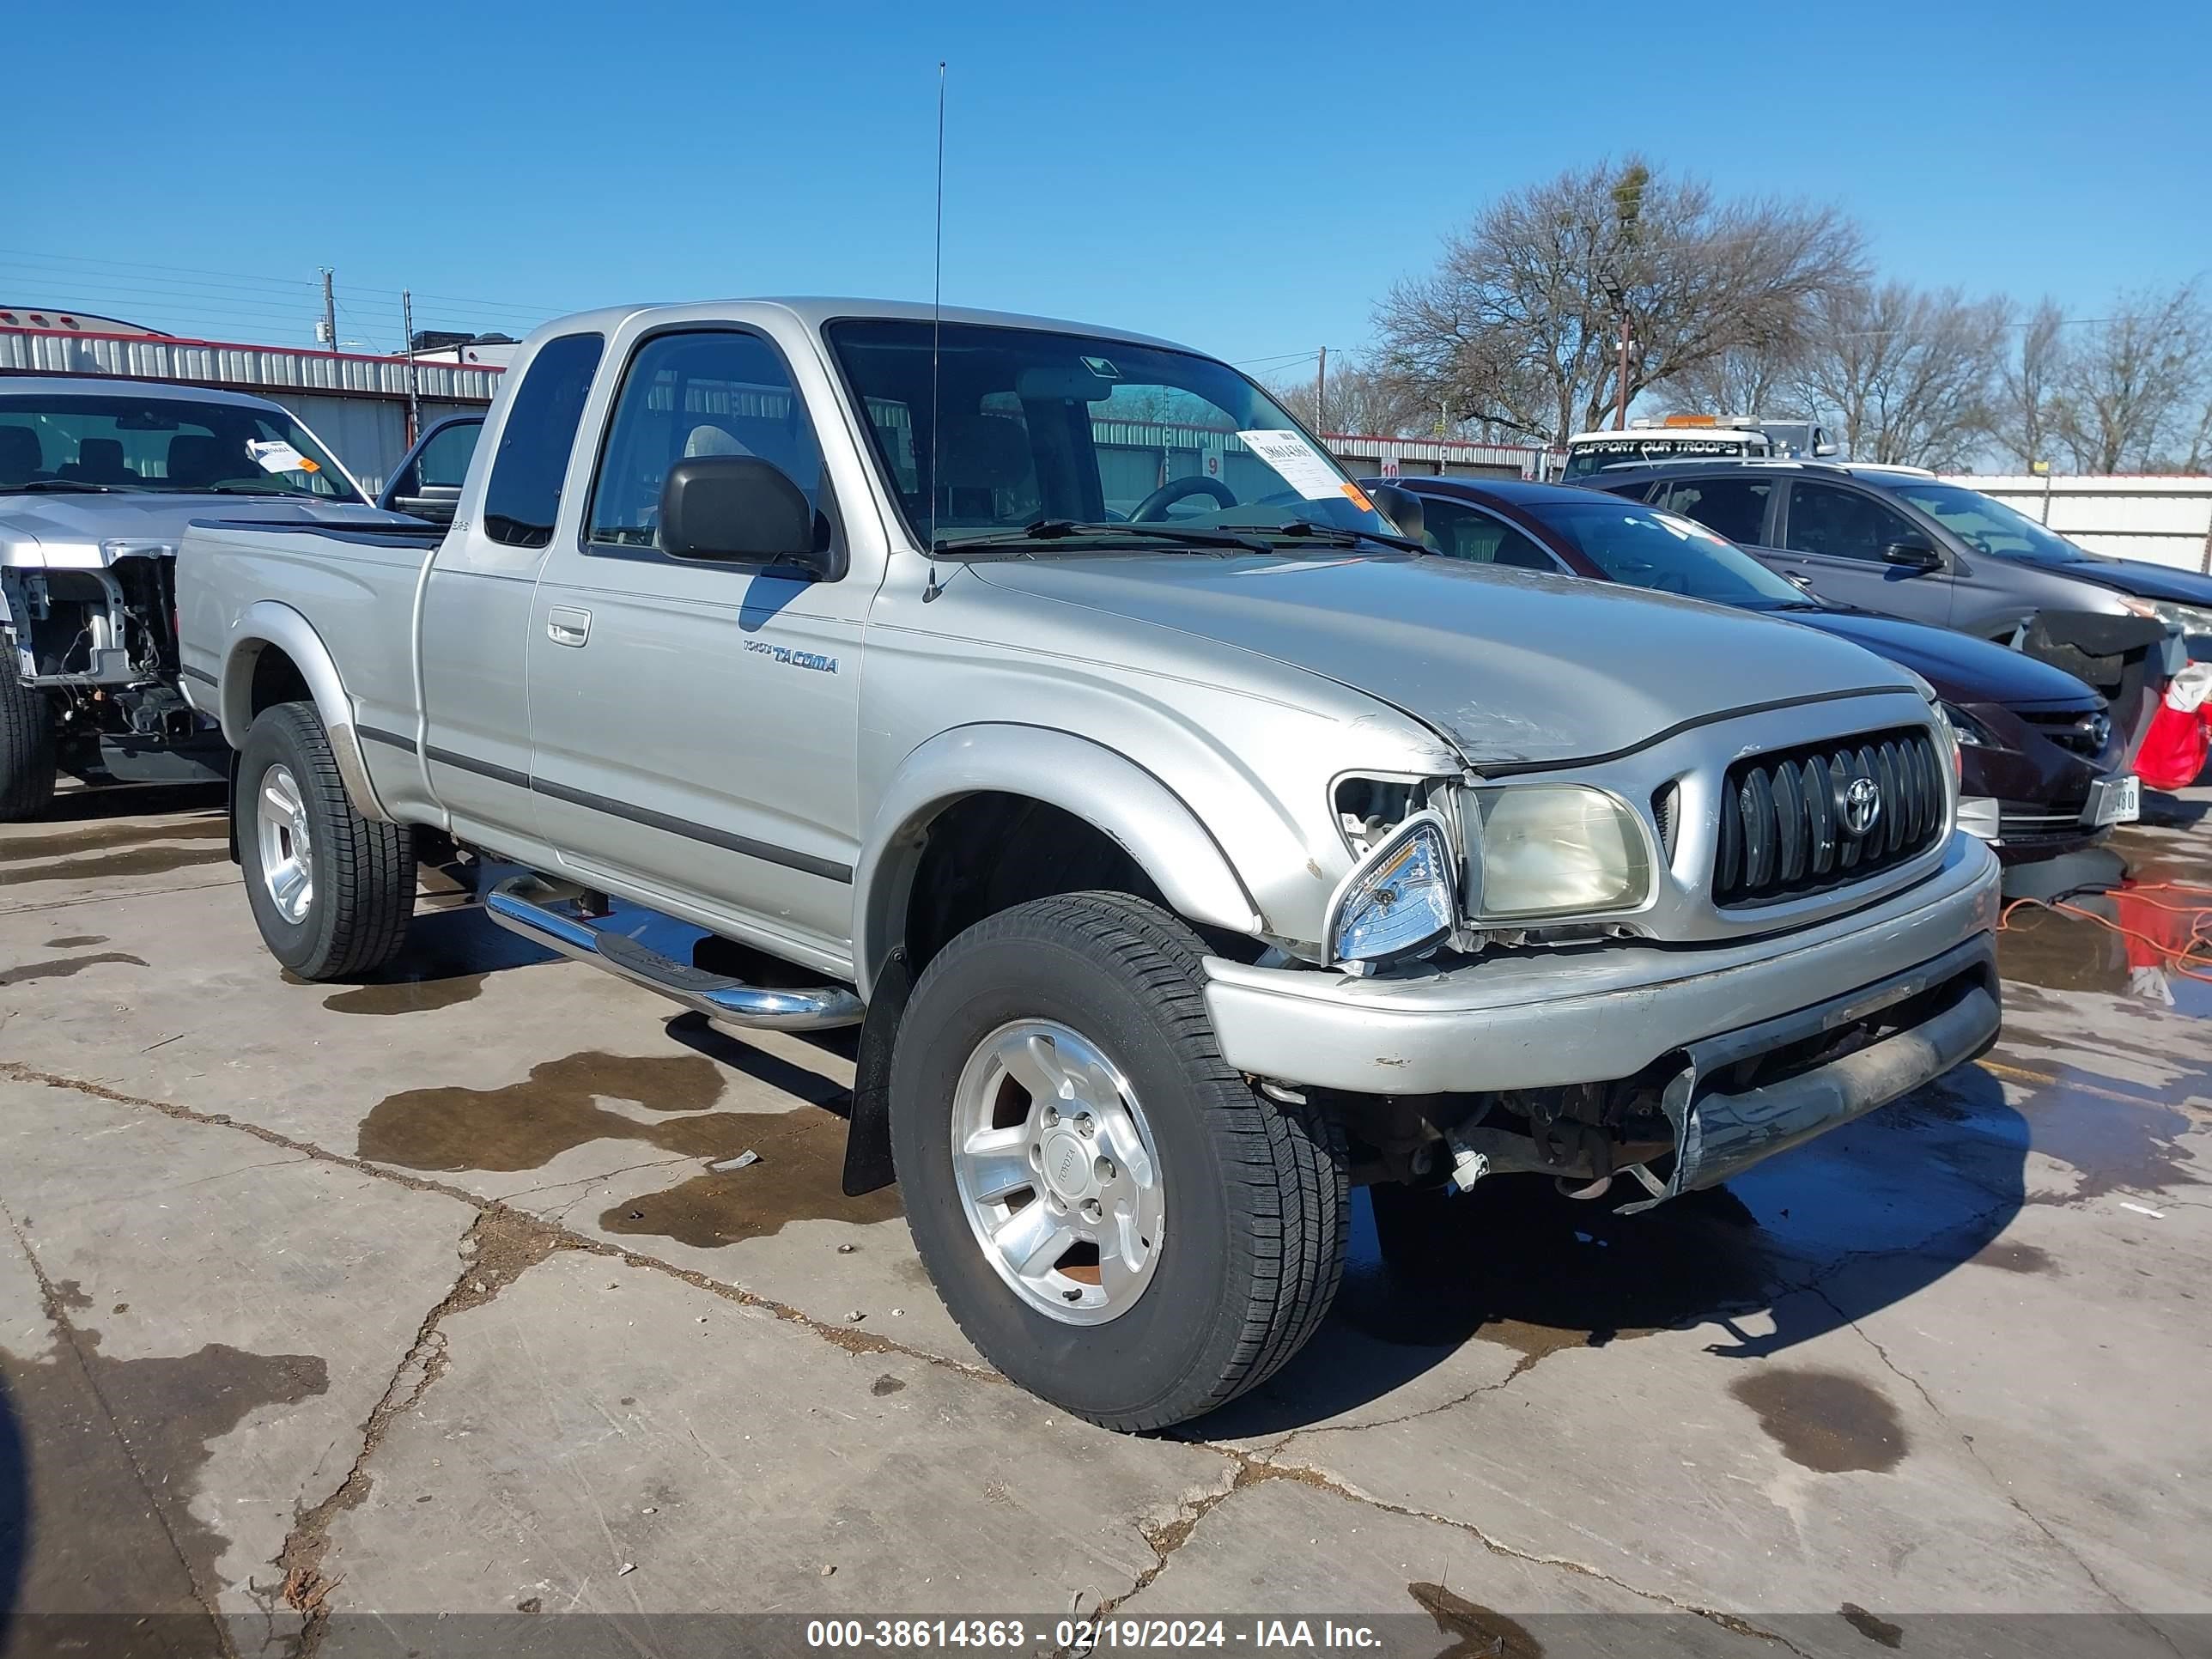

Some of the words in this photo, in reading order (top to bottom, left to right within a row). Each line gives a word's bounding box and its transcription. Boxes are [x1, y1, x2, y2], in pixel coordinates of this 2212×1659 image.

[1259, 444, 1312, 459] 38614363
[1575, 441, 1638, 455] SUPPORT
[1640, 440, 1672, 453] OUR
[1674, 441, 1738, 454] TROOPS
[1208, 456, 1218, 475] 9
[773, 647, 840, 675] TACOMA
[1058, 1149, 1076, 1182] TOYOTA
